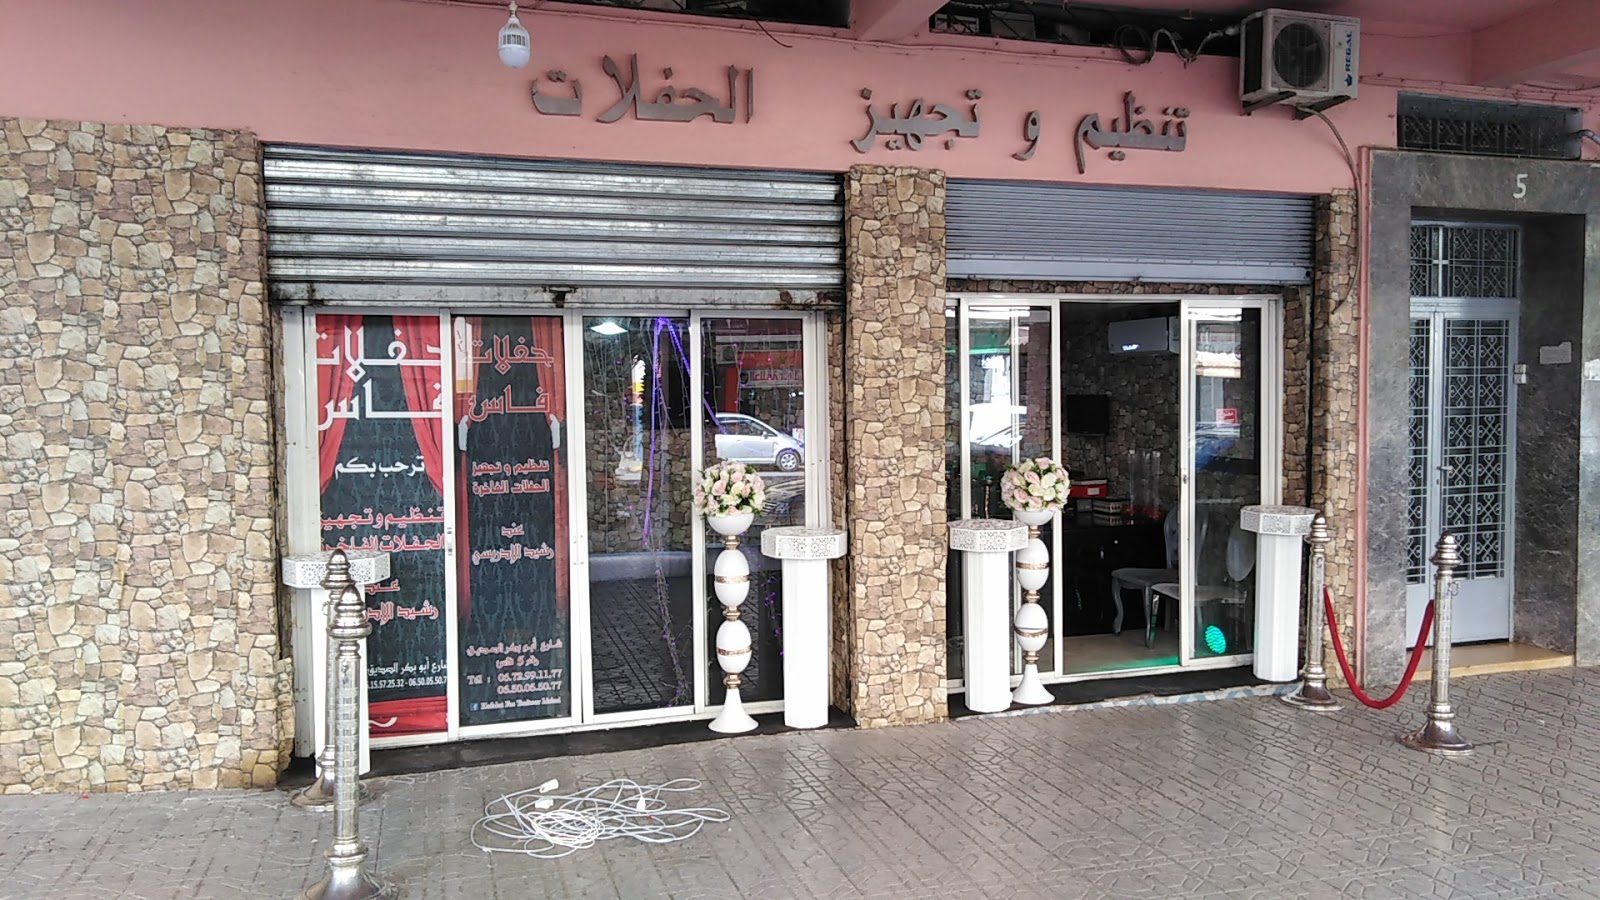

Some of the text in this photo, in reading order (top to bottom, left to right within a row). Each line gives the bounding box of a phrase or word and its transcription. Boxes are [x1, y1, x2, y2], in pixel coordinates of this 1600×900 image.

[531, 53, 1188, 174] تنظيم و تجهيز الحفلات
[1512, 174, 1528, 198] 5
[463, 334, 554, 375] حفلات
[468, 384, 551, 422] فاس
[334, 456, 377, 479] بكم
[503, 463, 512, 476] و
[513, 458, 550, 476] تنظيم
[408, 675, 447, 687] 06.50.05.50.7
